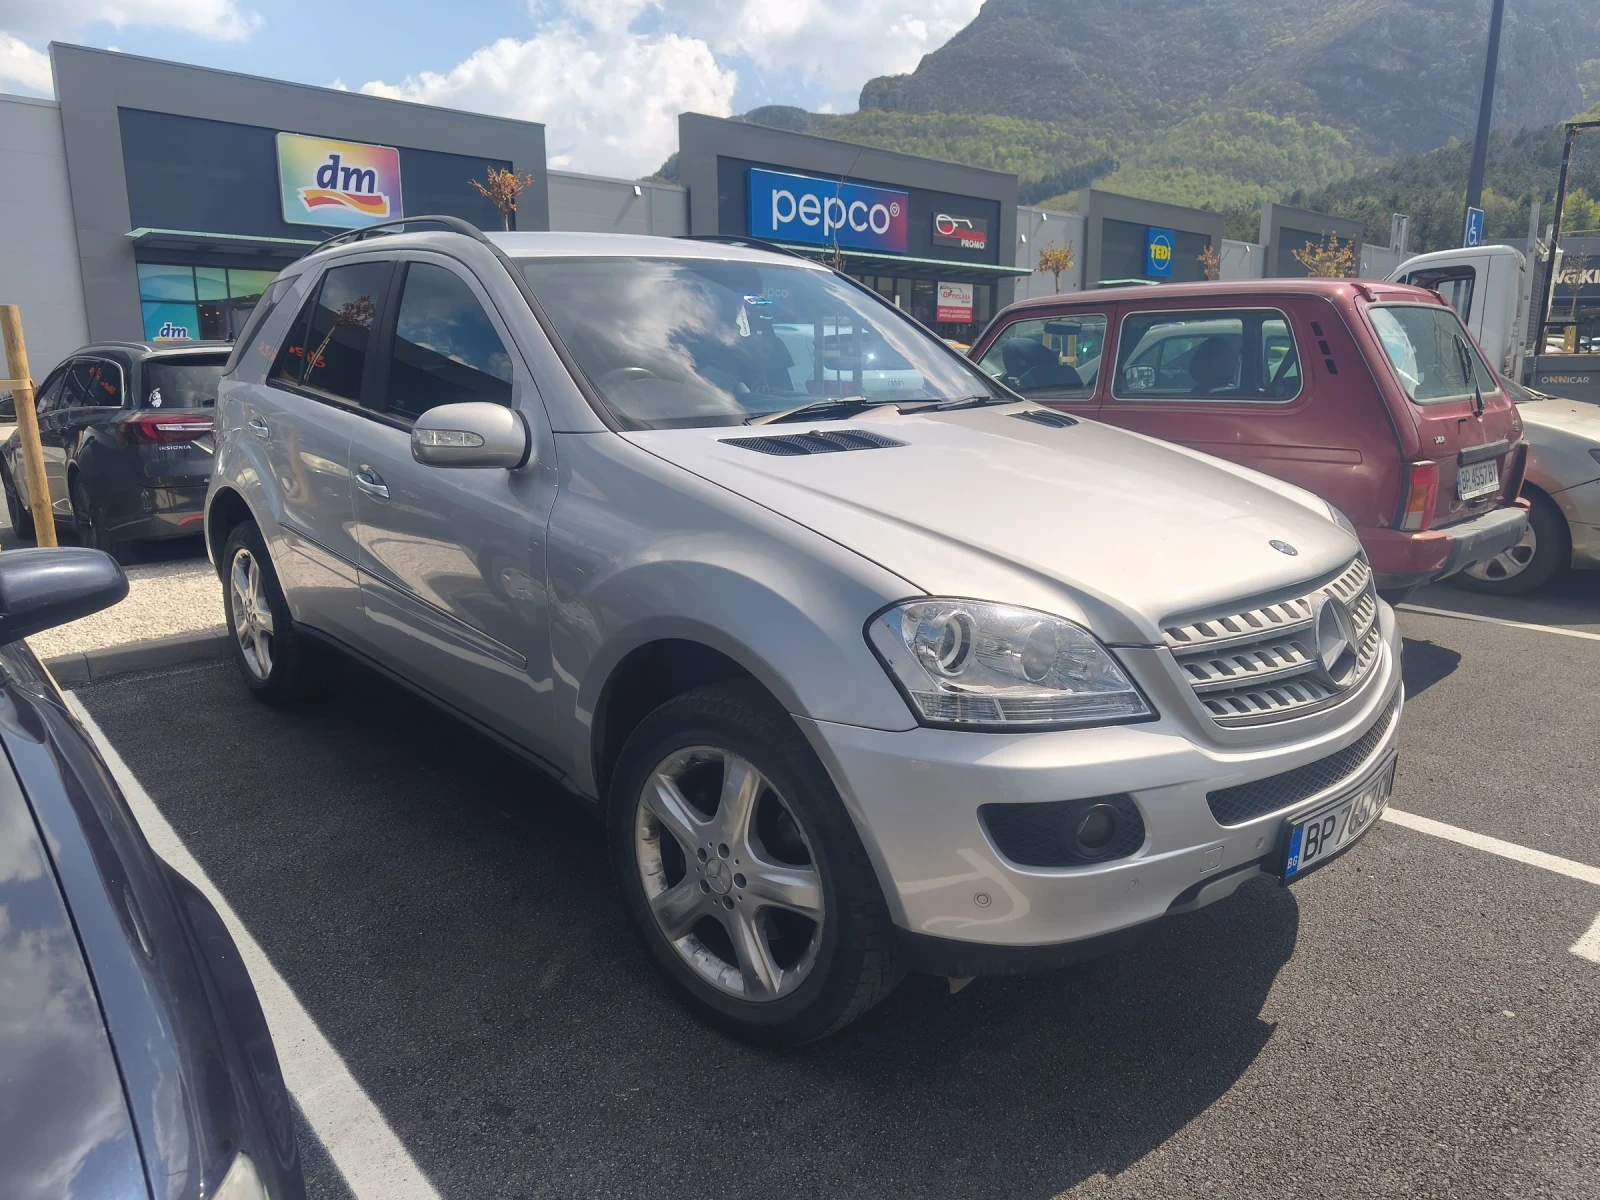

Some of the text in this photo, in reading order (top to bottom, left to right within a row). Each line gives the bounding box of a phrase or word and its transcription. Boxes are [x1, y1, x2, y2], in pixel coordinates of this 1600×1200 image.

[316, 154, 376, 194] dm
[772, 189, 890, 236] pepco
[961, 238, 985, 249] PROMO
[160, 323, 187, 338] dm
[1541, 375, 1590, 384] ONNICAR
[1303, 814, 1336, 862] BP
[1287, 855, 1299, 869] BG
